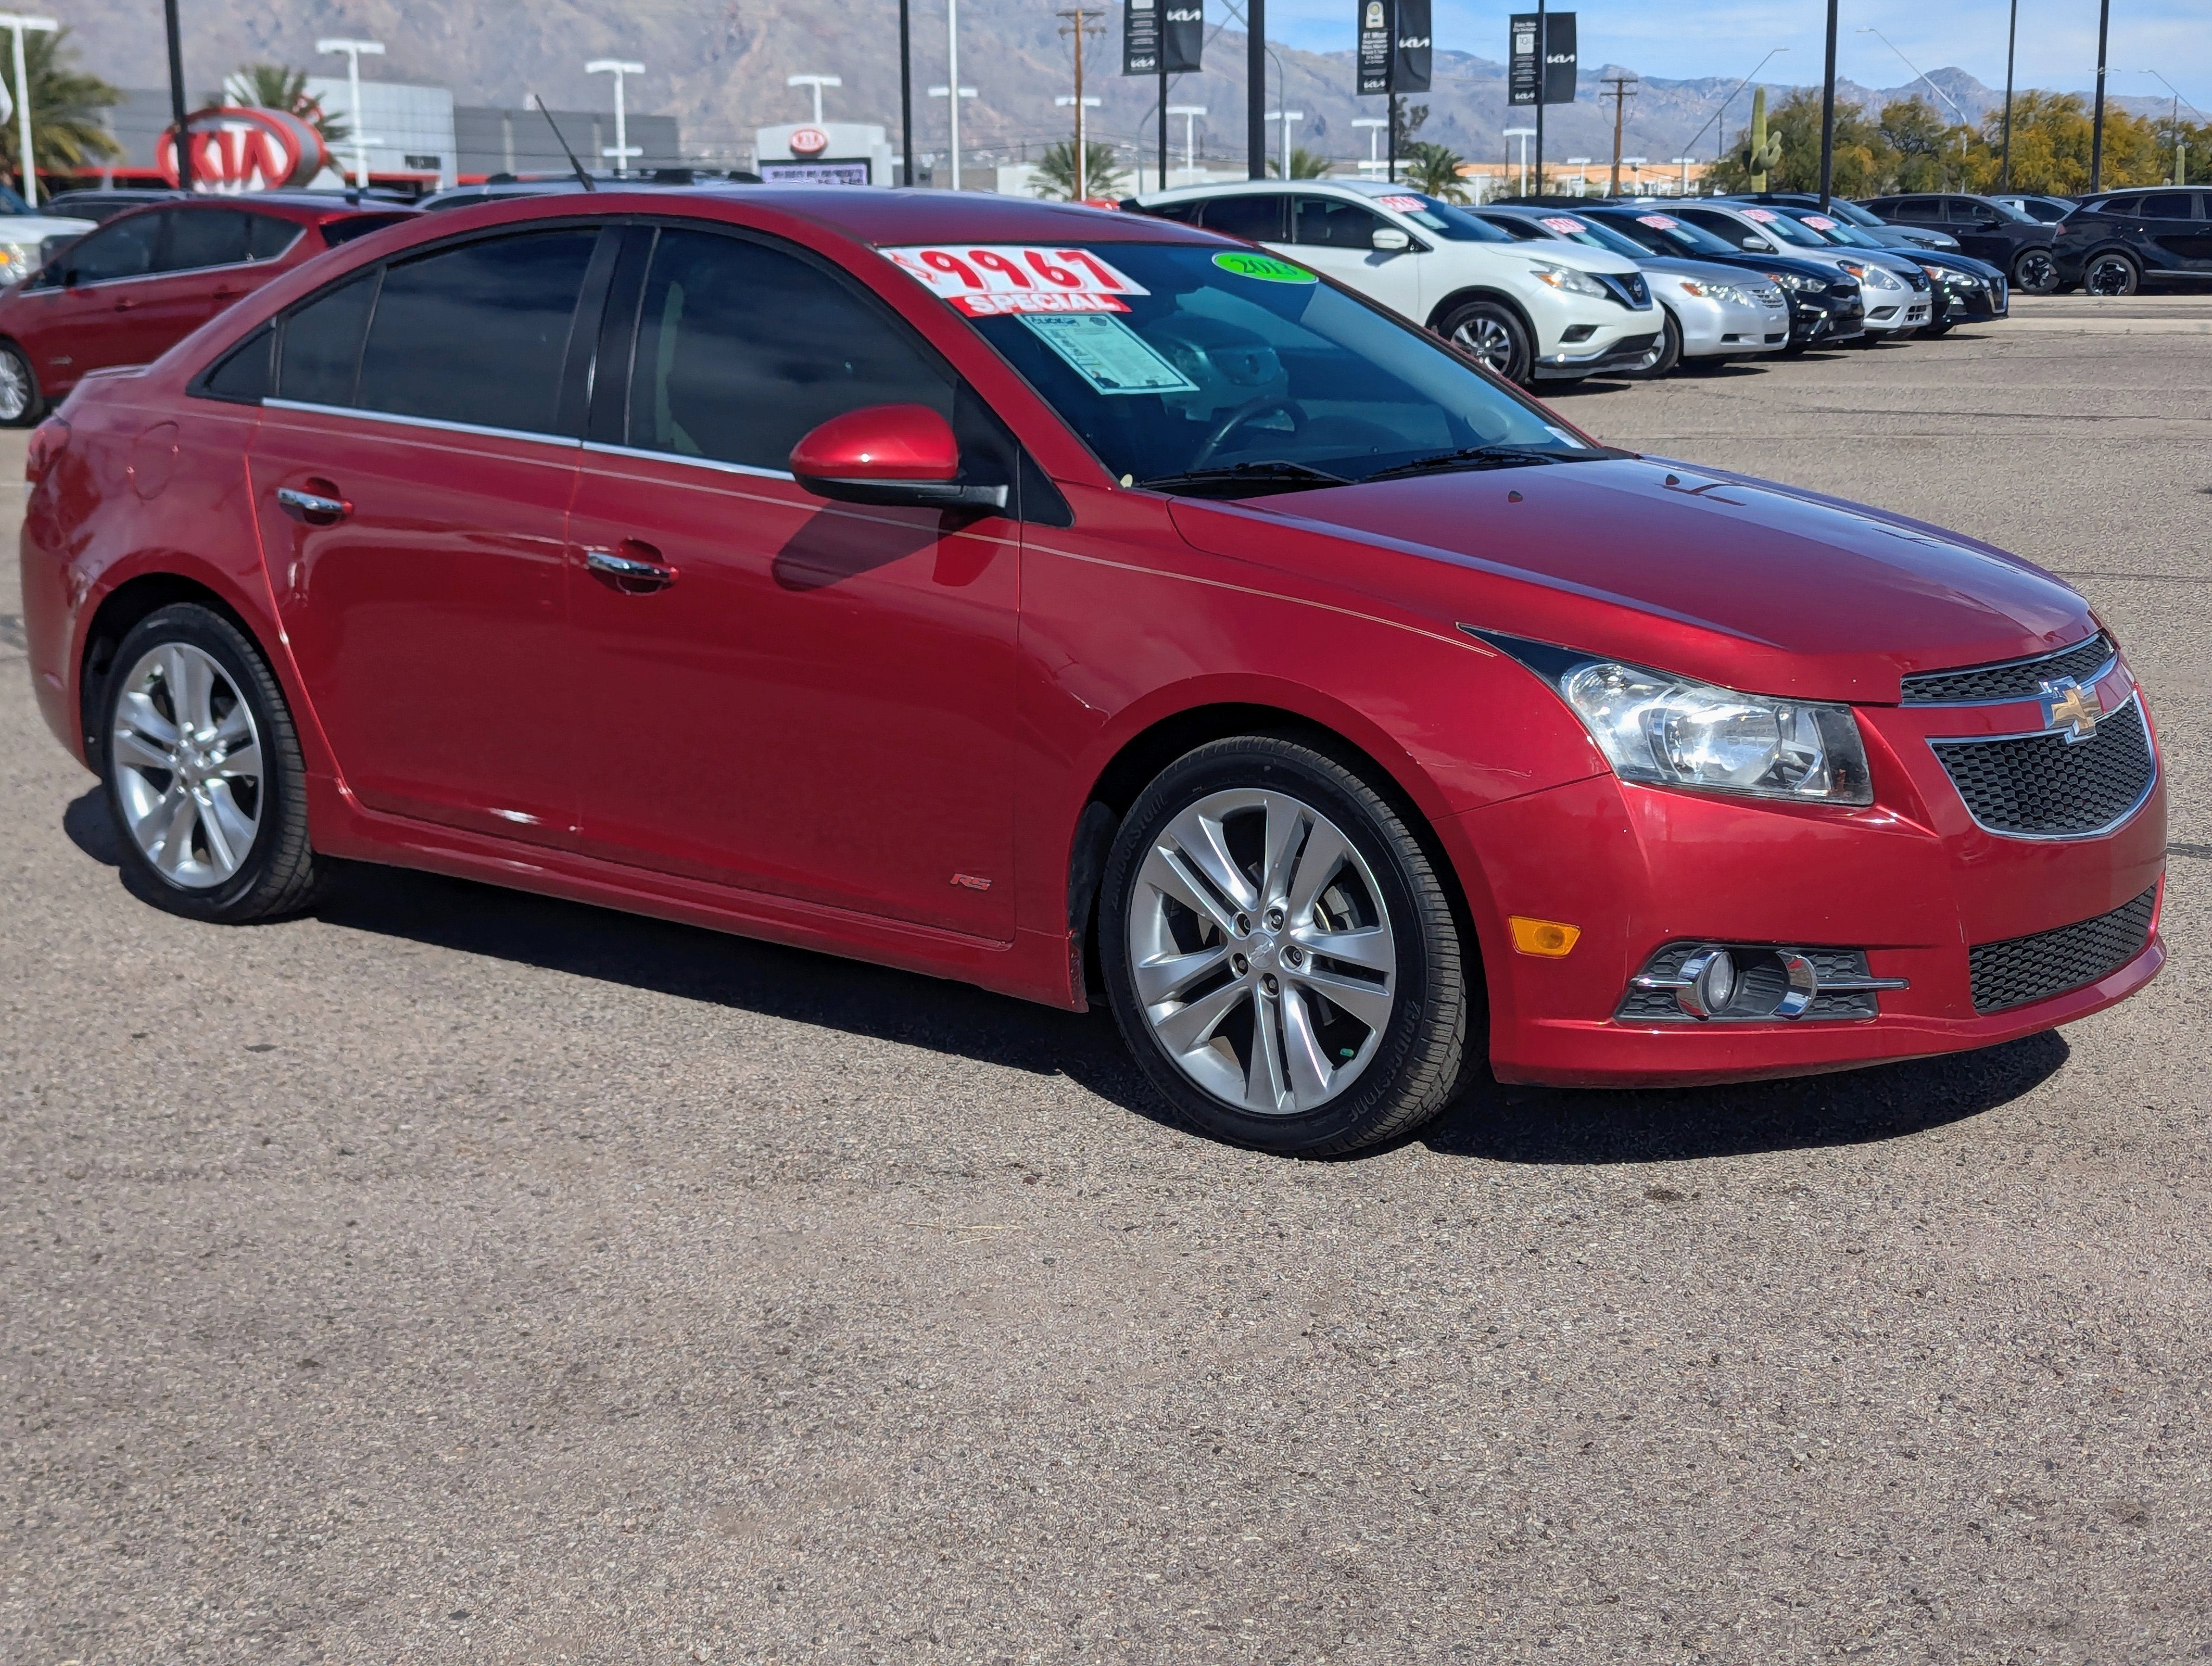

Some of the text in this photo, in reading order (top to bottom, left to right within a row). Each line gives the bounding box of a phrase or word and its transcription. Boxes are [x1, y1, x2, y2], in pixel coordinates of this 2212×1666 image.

[185, 130, 280, 182] KIA
[964, 293, 1120, 313] SPECIAL
[950, 873, 992, 890] RS
